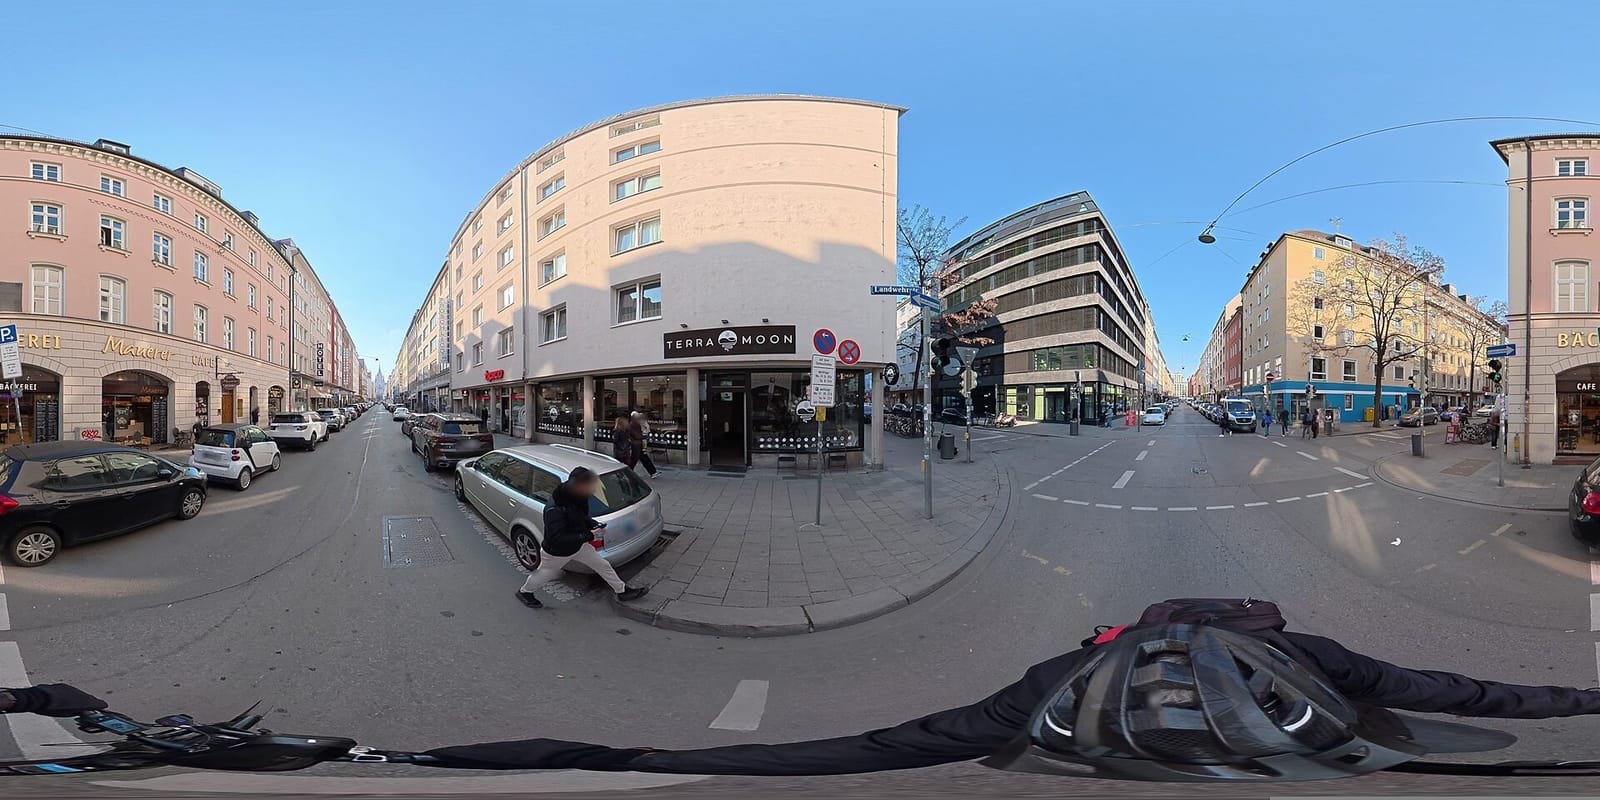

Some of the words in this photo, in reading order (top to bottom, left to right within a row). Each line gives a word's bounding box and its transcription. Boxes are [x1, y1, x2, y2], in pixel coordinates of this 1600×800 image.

[102, 335, 175, 361] Mauerer
[666, 338, 714, 350] TERRA
[742, 334, 793, 345] MOON
[1576, 383, 1596, 391] CAFE
